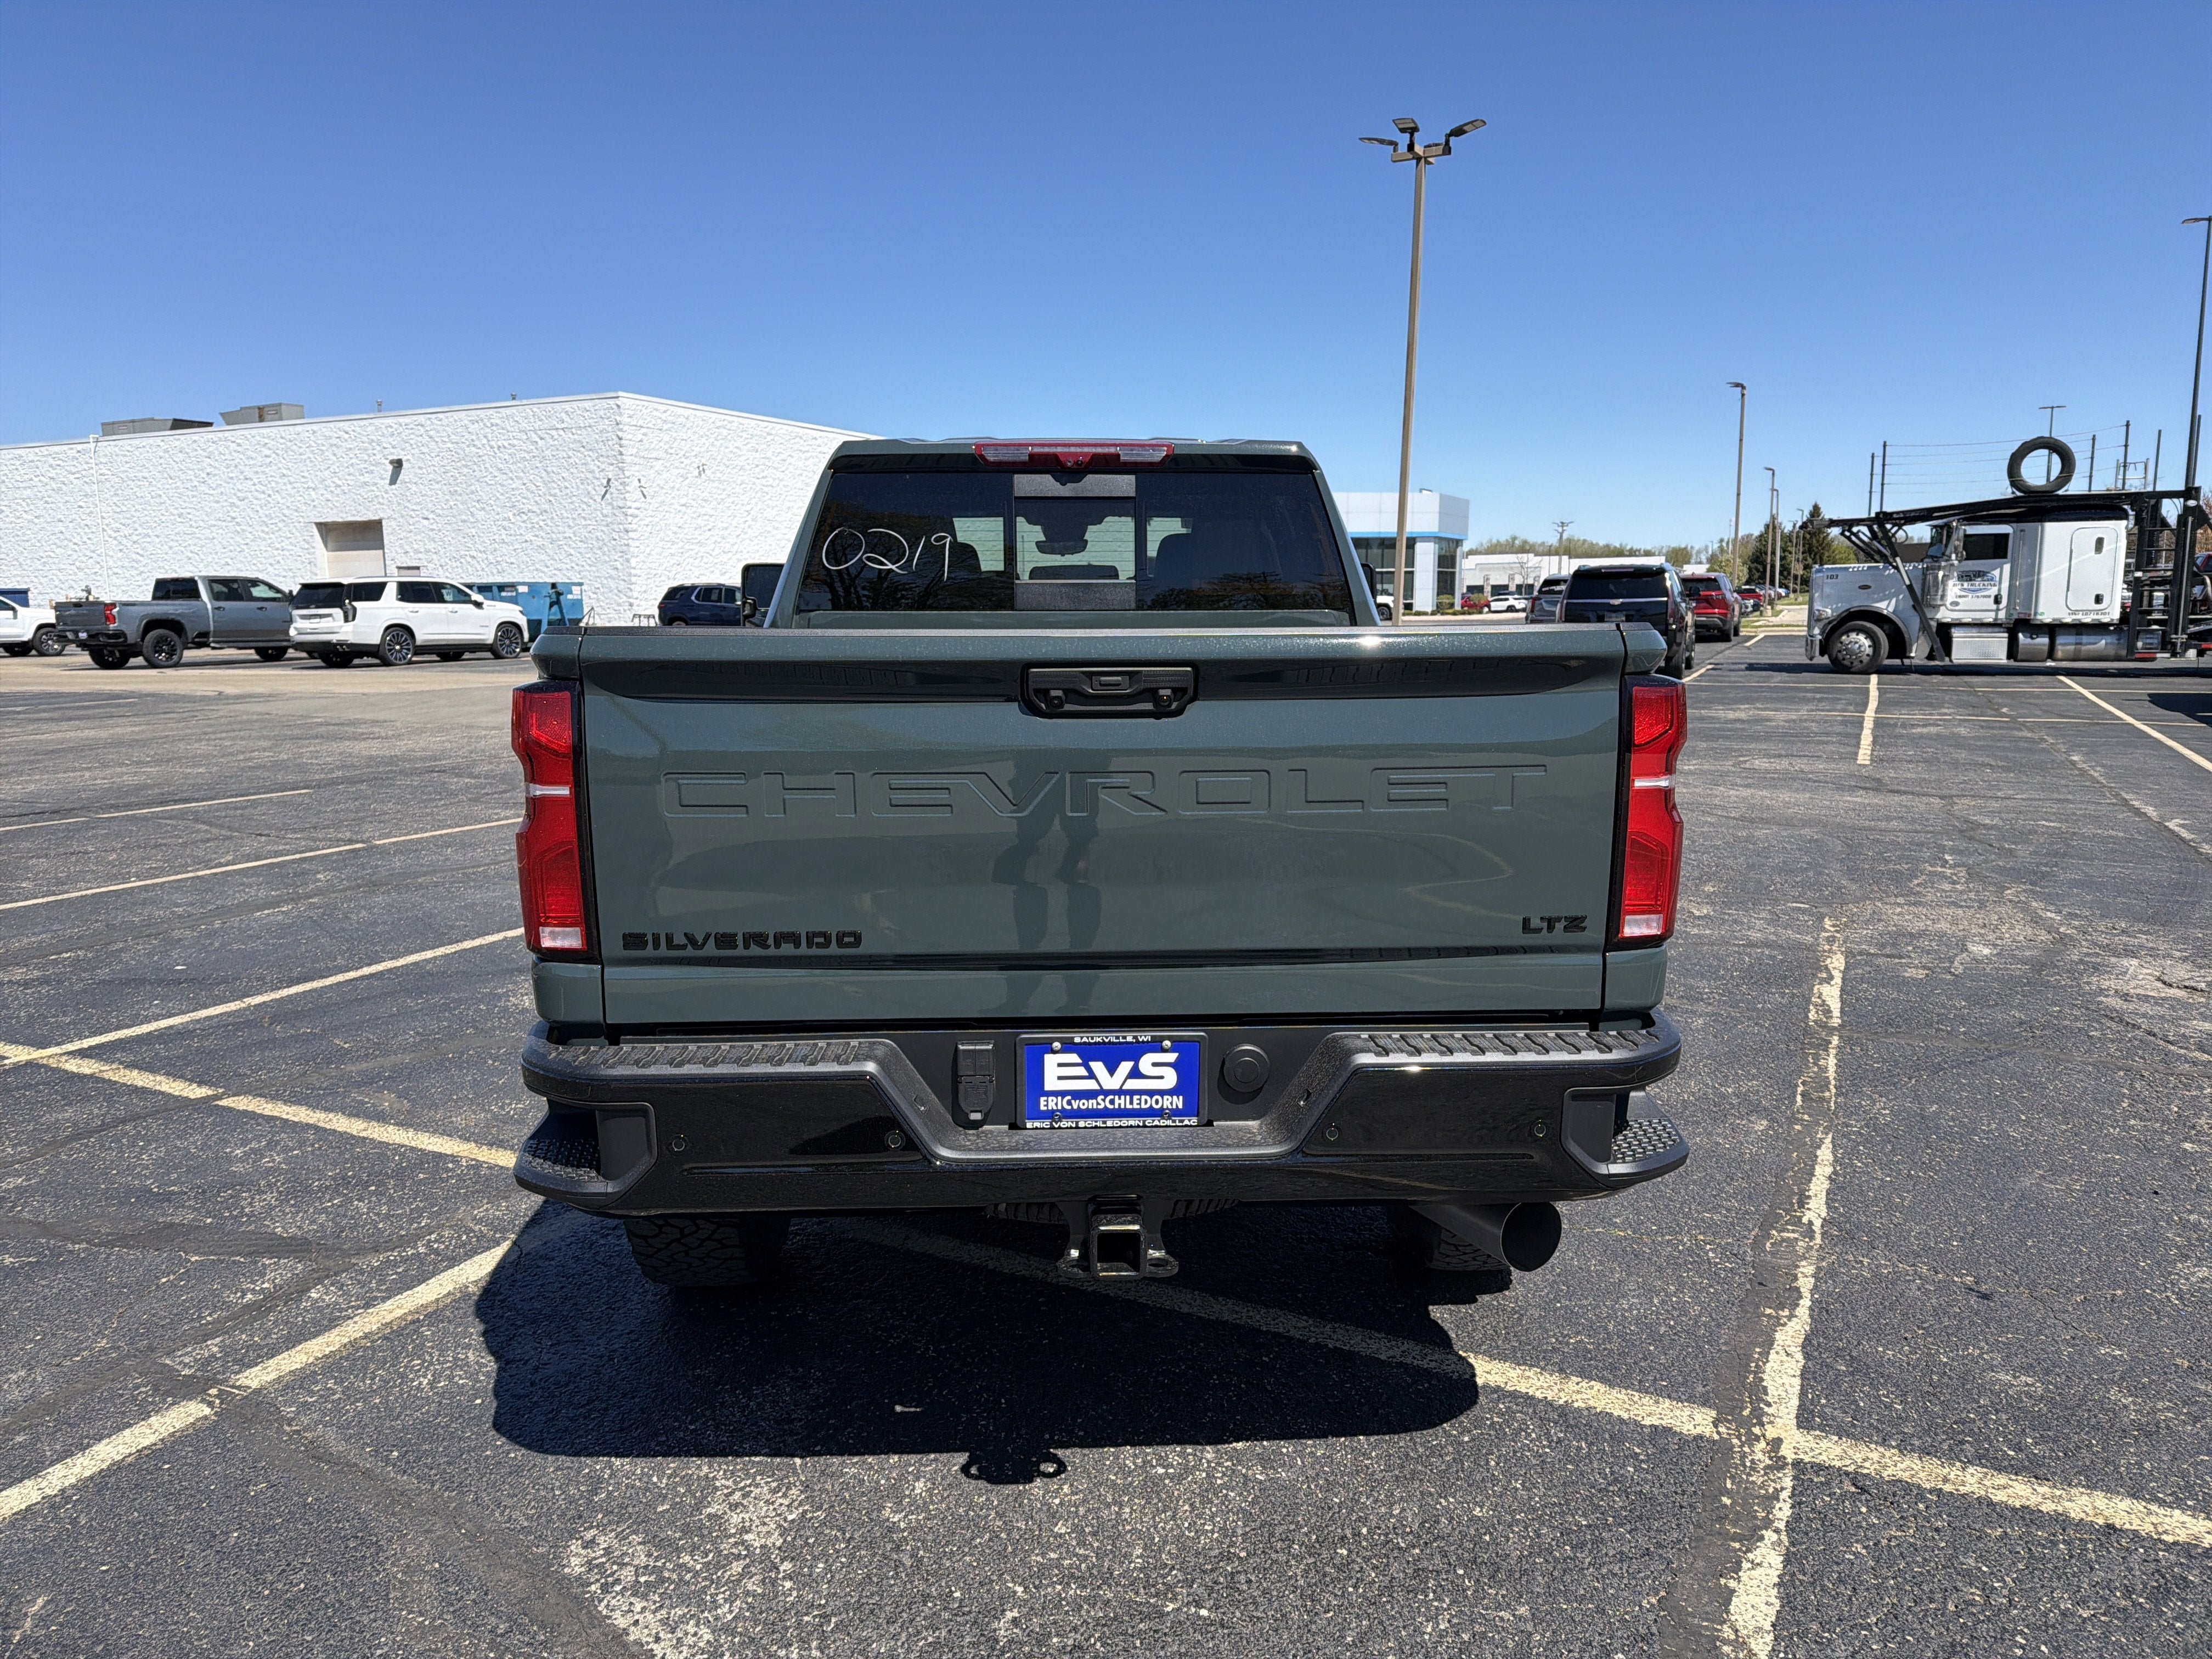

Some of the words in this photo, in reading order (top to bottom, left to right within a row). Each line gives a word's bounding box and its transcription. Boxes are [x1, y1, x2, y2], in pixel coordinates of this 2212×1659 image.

[822, 527, 953, 582] 0219
[662, 764, 1547, 817] CHEVROLET
[622, 930, 862, 951] SILVERADO
[1521, 915, 1587, 934] LTZ
